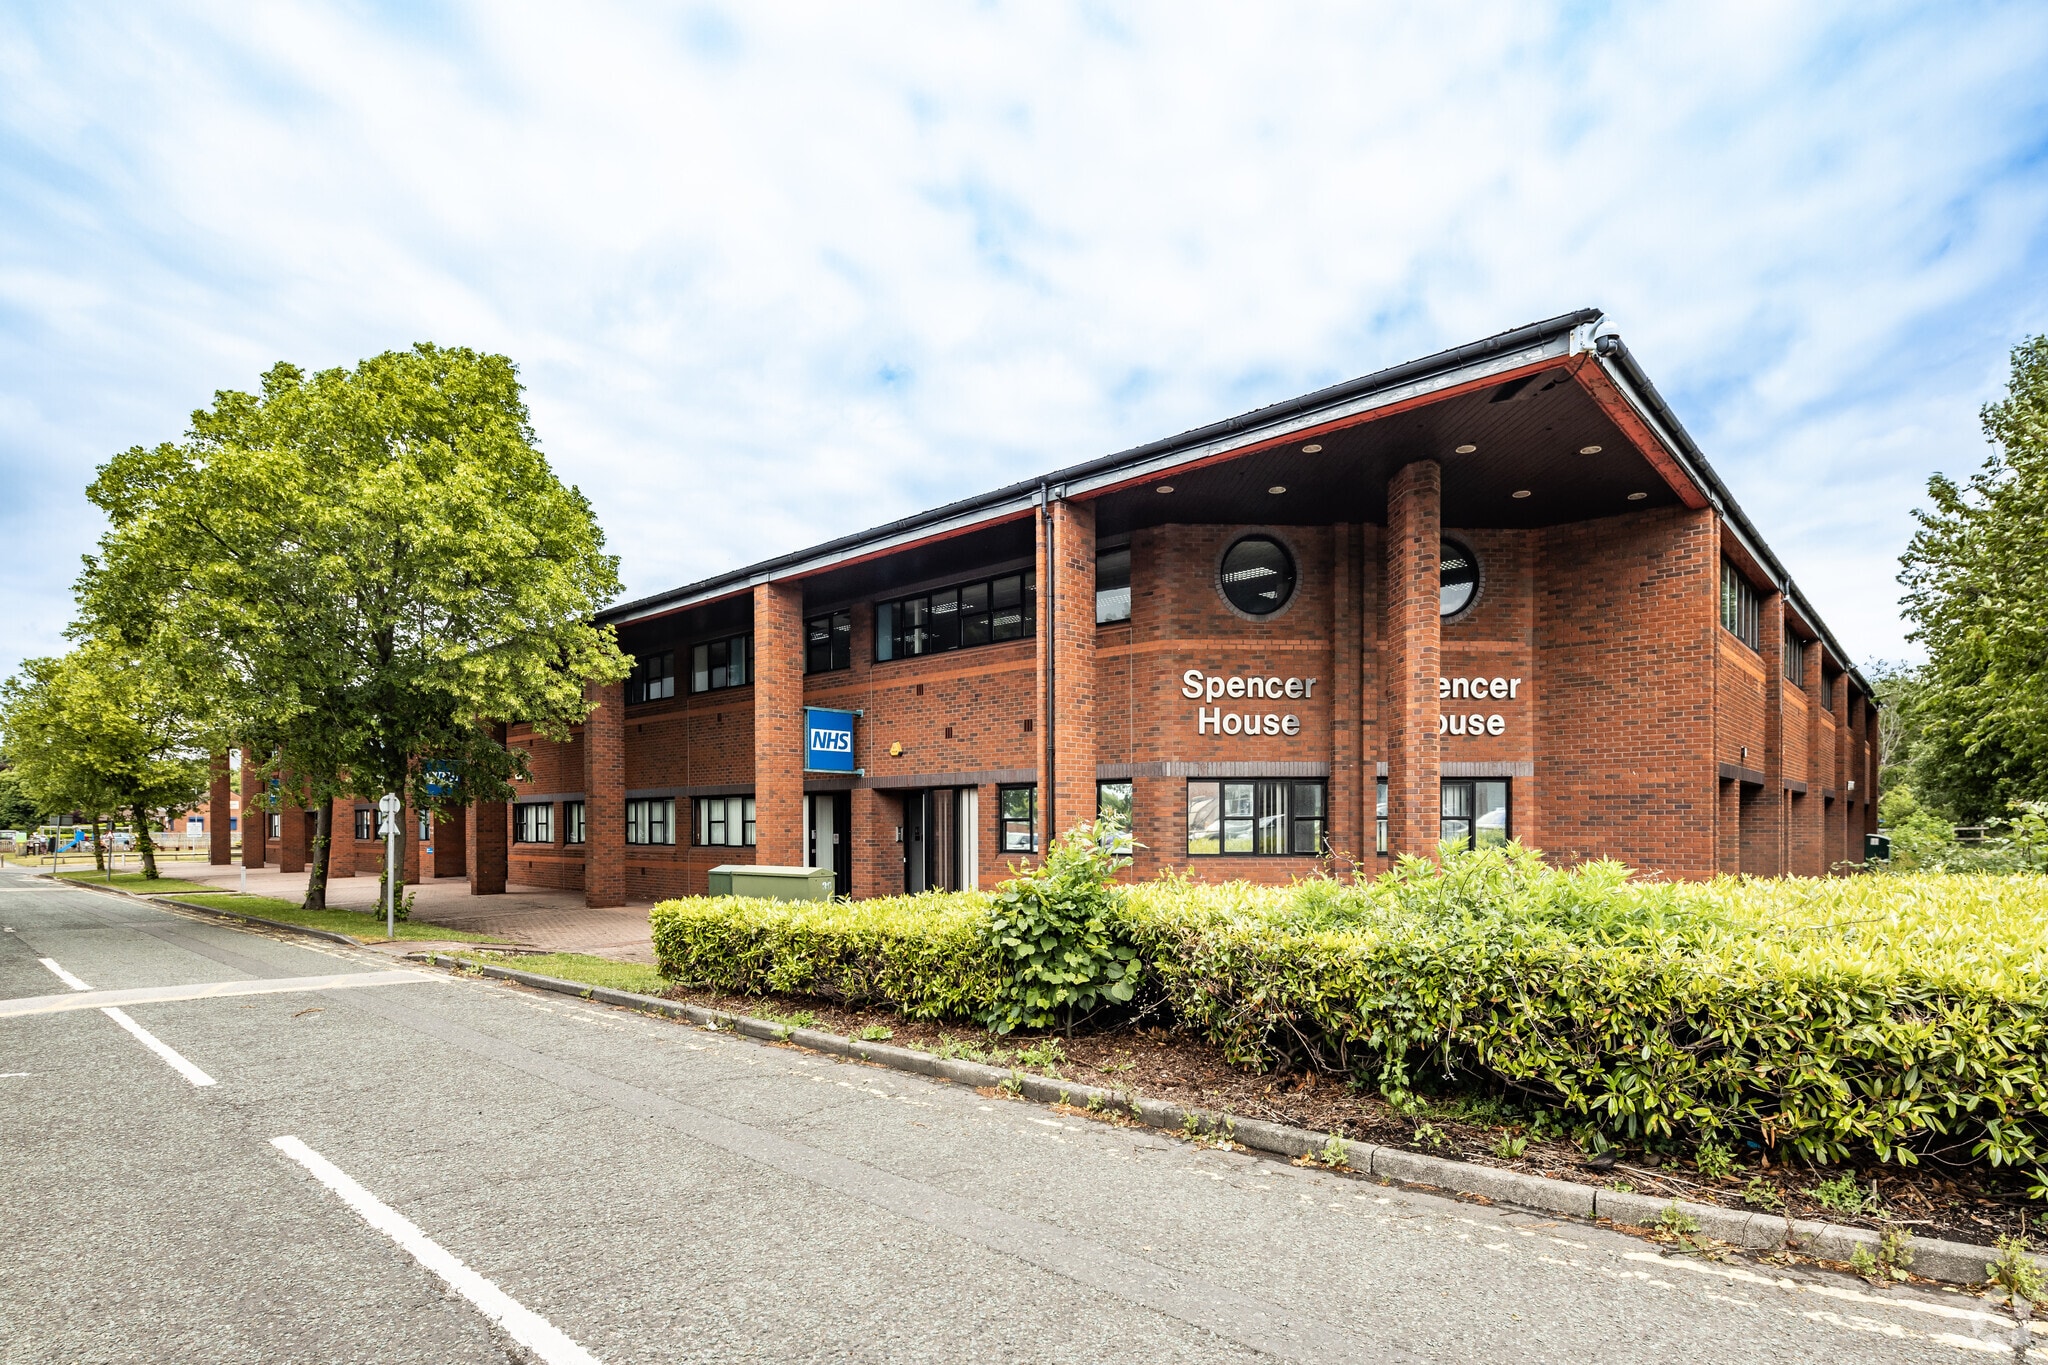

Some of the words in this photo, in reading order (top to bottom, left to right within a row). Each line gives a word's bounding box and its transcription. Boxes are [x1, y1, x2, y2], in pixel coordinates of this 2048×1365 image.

[1181, 669, 1317, 704] Spencer
[1440, 677, 1521, 699] encer
[1198, 706, 1300, 735] House
[1440, 714, 1505, 735] use
[812, 731, 849, 750] NHS
